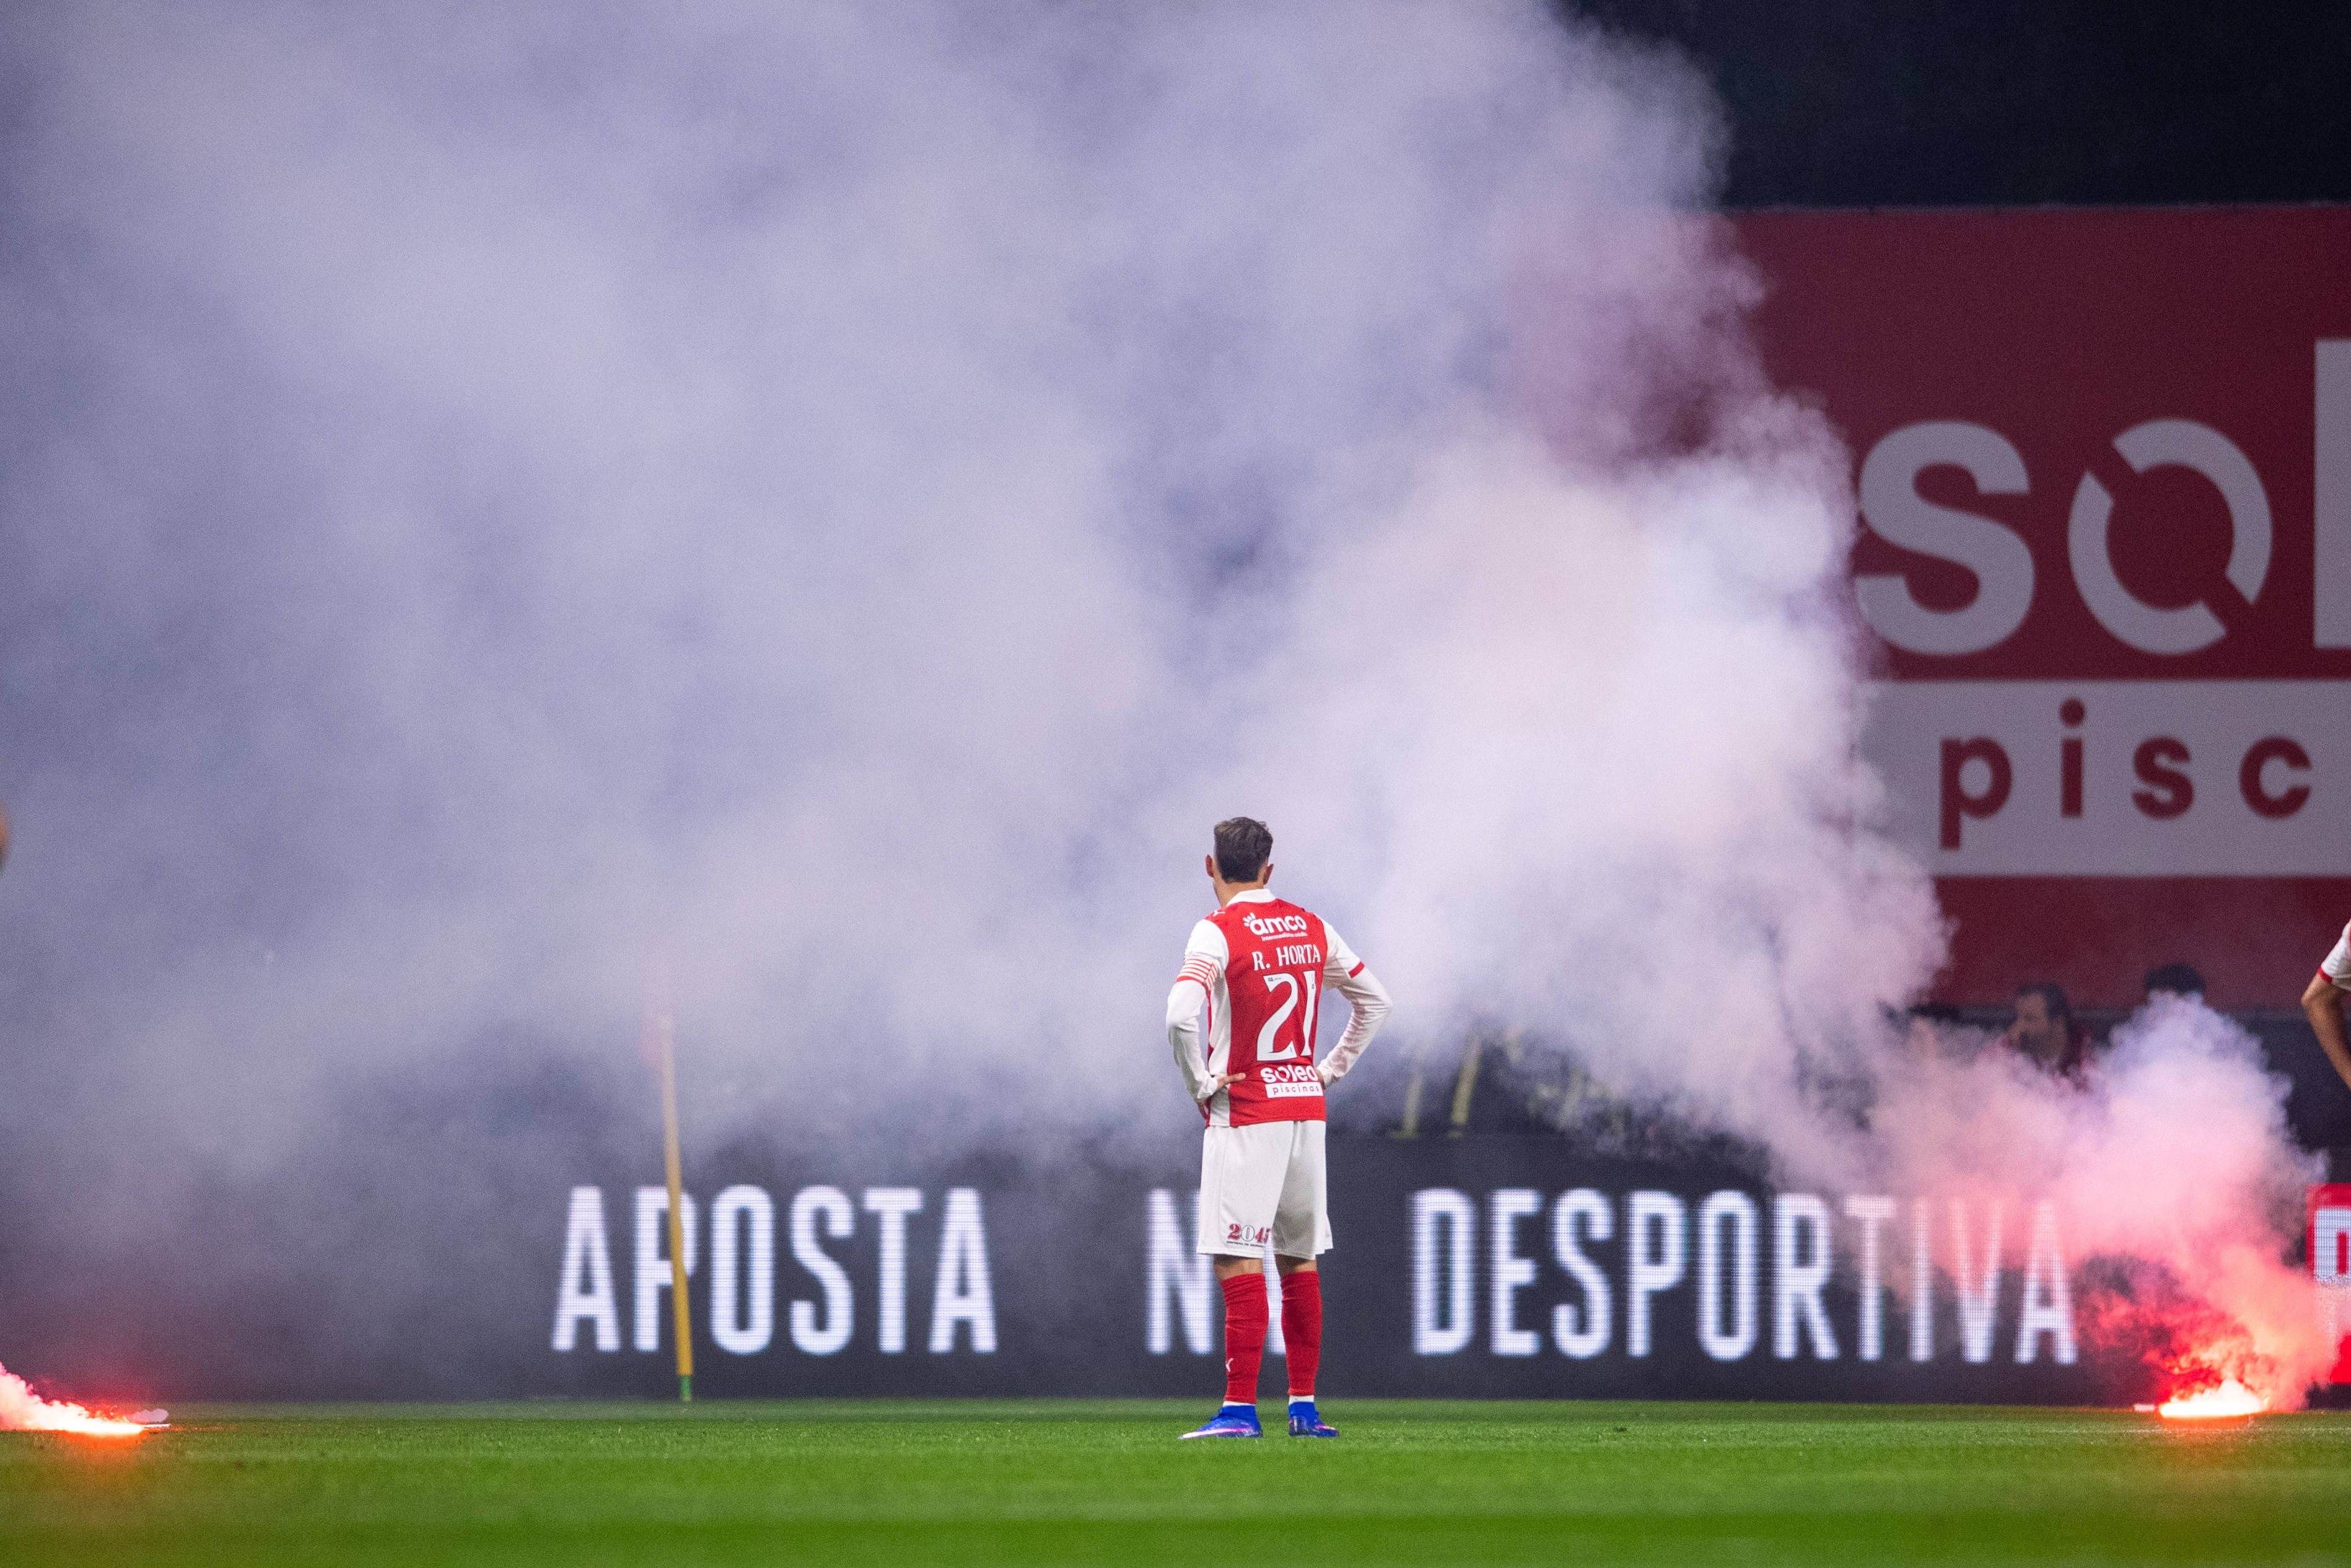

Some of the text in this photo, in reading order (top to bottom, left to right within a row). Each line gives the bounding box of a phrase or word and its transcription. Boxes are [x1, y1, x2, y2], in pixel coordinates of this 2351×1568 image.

[1940, 698, 2312, 850] pisc
[1250, 915, 1307, 935] amco
[1252, 944, 1321, 971] R. HORTA
[1257, 970, 1316, 1061] 21
[1260, 1064, 1318, 1084] soleo
[1272, 1084, 1320, 1095] piscinas
[552, 1185, 2077, 1364] APOSTA N DESPORTIVA
